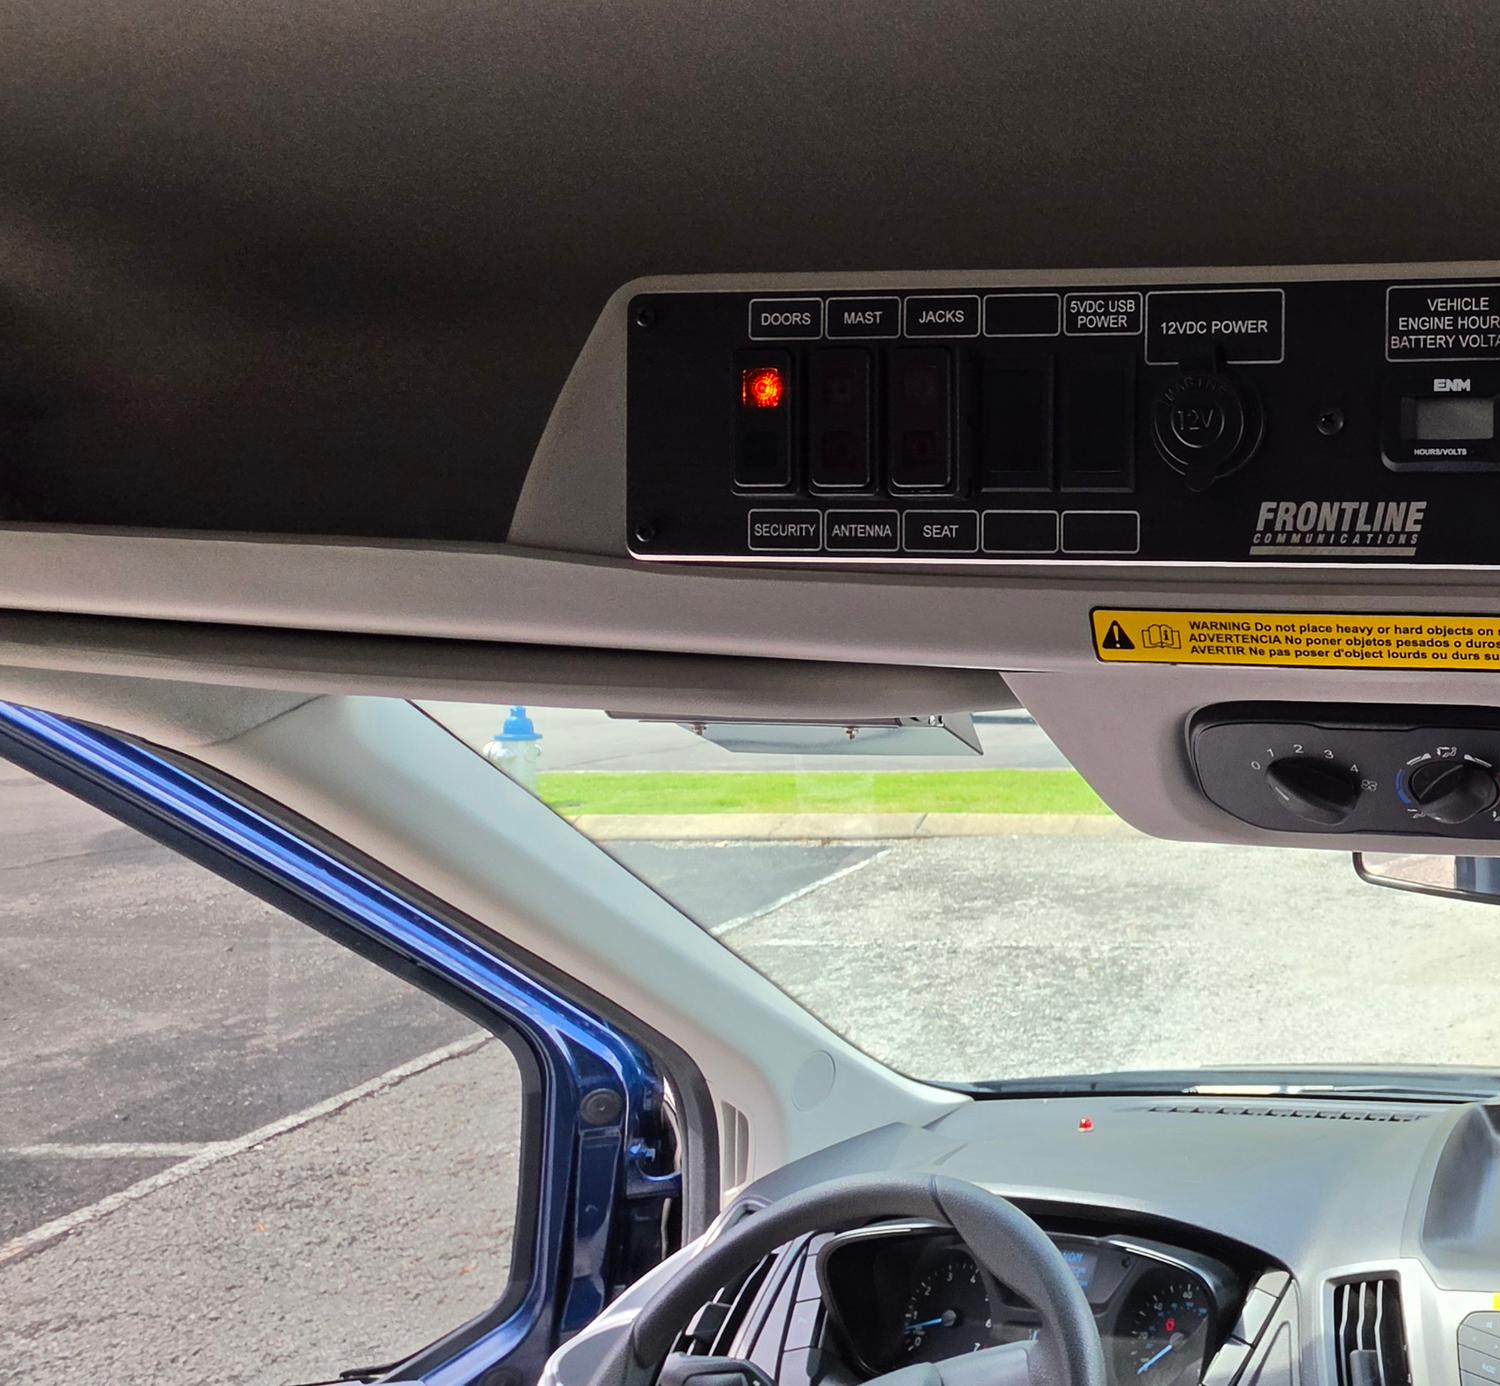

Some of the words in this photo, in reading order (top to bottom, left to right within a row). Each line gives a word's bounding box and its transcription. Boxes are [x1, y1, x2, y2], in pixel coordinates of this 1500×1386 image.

[1071, 301, 1106, 314] 5VDC
[1109, 300, 1135, 313] USB
[1428, 298, 1489, 312] VEHICLE
[761, 312, 811, 325] DOORS
[844, 312, 882, 324] MAST
[919, 311, 964, 324] JACKS
[1078, 315, 1128, 328] POWER
[1399, 316, 1454, 331] ENGINE
[1161, 321, 1207, 335] 12VDC
[1211, 320, 1268, 334] POWER
[1391, 335, 1456, 349] BATTERY
[1434, 379, 1471, 391] ENM
[1177, 409, 1214, 431] 12V
[1413, 448, 1468, 456] HOURS/VOLTS
[1255, 501, 1427, 532] FRONTLINE
[755, 524, 815, 538] SECURITY
[832, 524, 891, 538] ANTENNA
[923, 525, 958, 538] SEAT
[1253, 533, 1419, 544] COMMUNICATIONS
[1189, 621, 1251, 631] WARNING
[1255, 622, 1271, 632] Do
[1276, 623, 1296, 632] not
[1300, 623, 1332, 634] place
[1336, 624, 1373, 636] heavy
[1377, 626, 1391, 634] or
[1394, 625, 1423, 635] hard
[1427, 626, 1473, 637] objects
[1477, 628, 1494, 636] on
[1189, 633, 1281, 644] ADVERTENCIA
[1285, 635, 1302, 645] No
[1306, 637, 1342, 647] poner
[1345, 636, 1392, 648] objetos
[1396, 638, 1450, 648] pesados
[1454, 640, 1462, 648] o
[1190, 645, 1245, 655] AVERTIR
[1248, 646, 1265, 656] Ne
[1269, 648, 1291, 658] pas
[1294, 649, 1329, 659] poser
[1334, 648, 1383, 660] d'object
[1388, 650, 1428, 660] lourds
[1432, 652, 1448, 660] ou
[1452, 651, 1480, 661] durs
[1267, 748, 1274, 757] 1
[1293, 744, 1304, 753] 2
[1324, 749, 1334, 759] 3
[1251, 761, 1260, 770] 0
[1350, 764, 1359, 773] 4
[985, 1318, 992, 1328] 6
